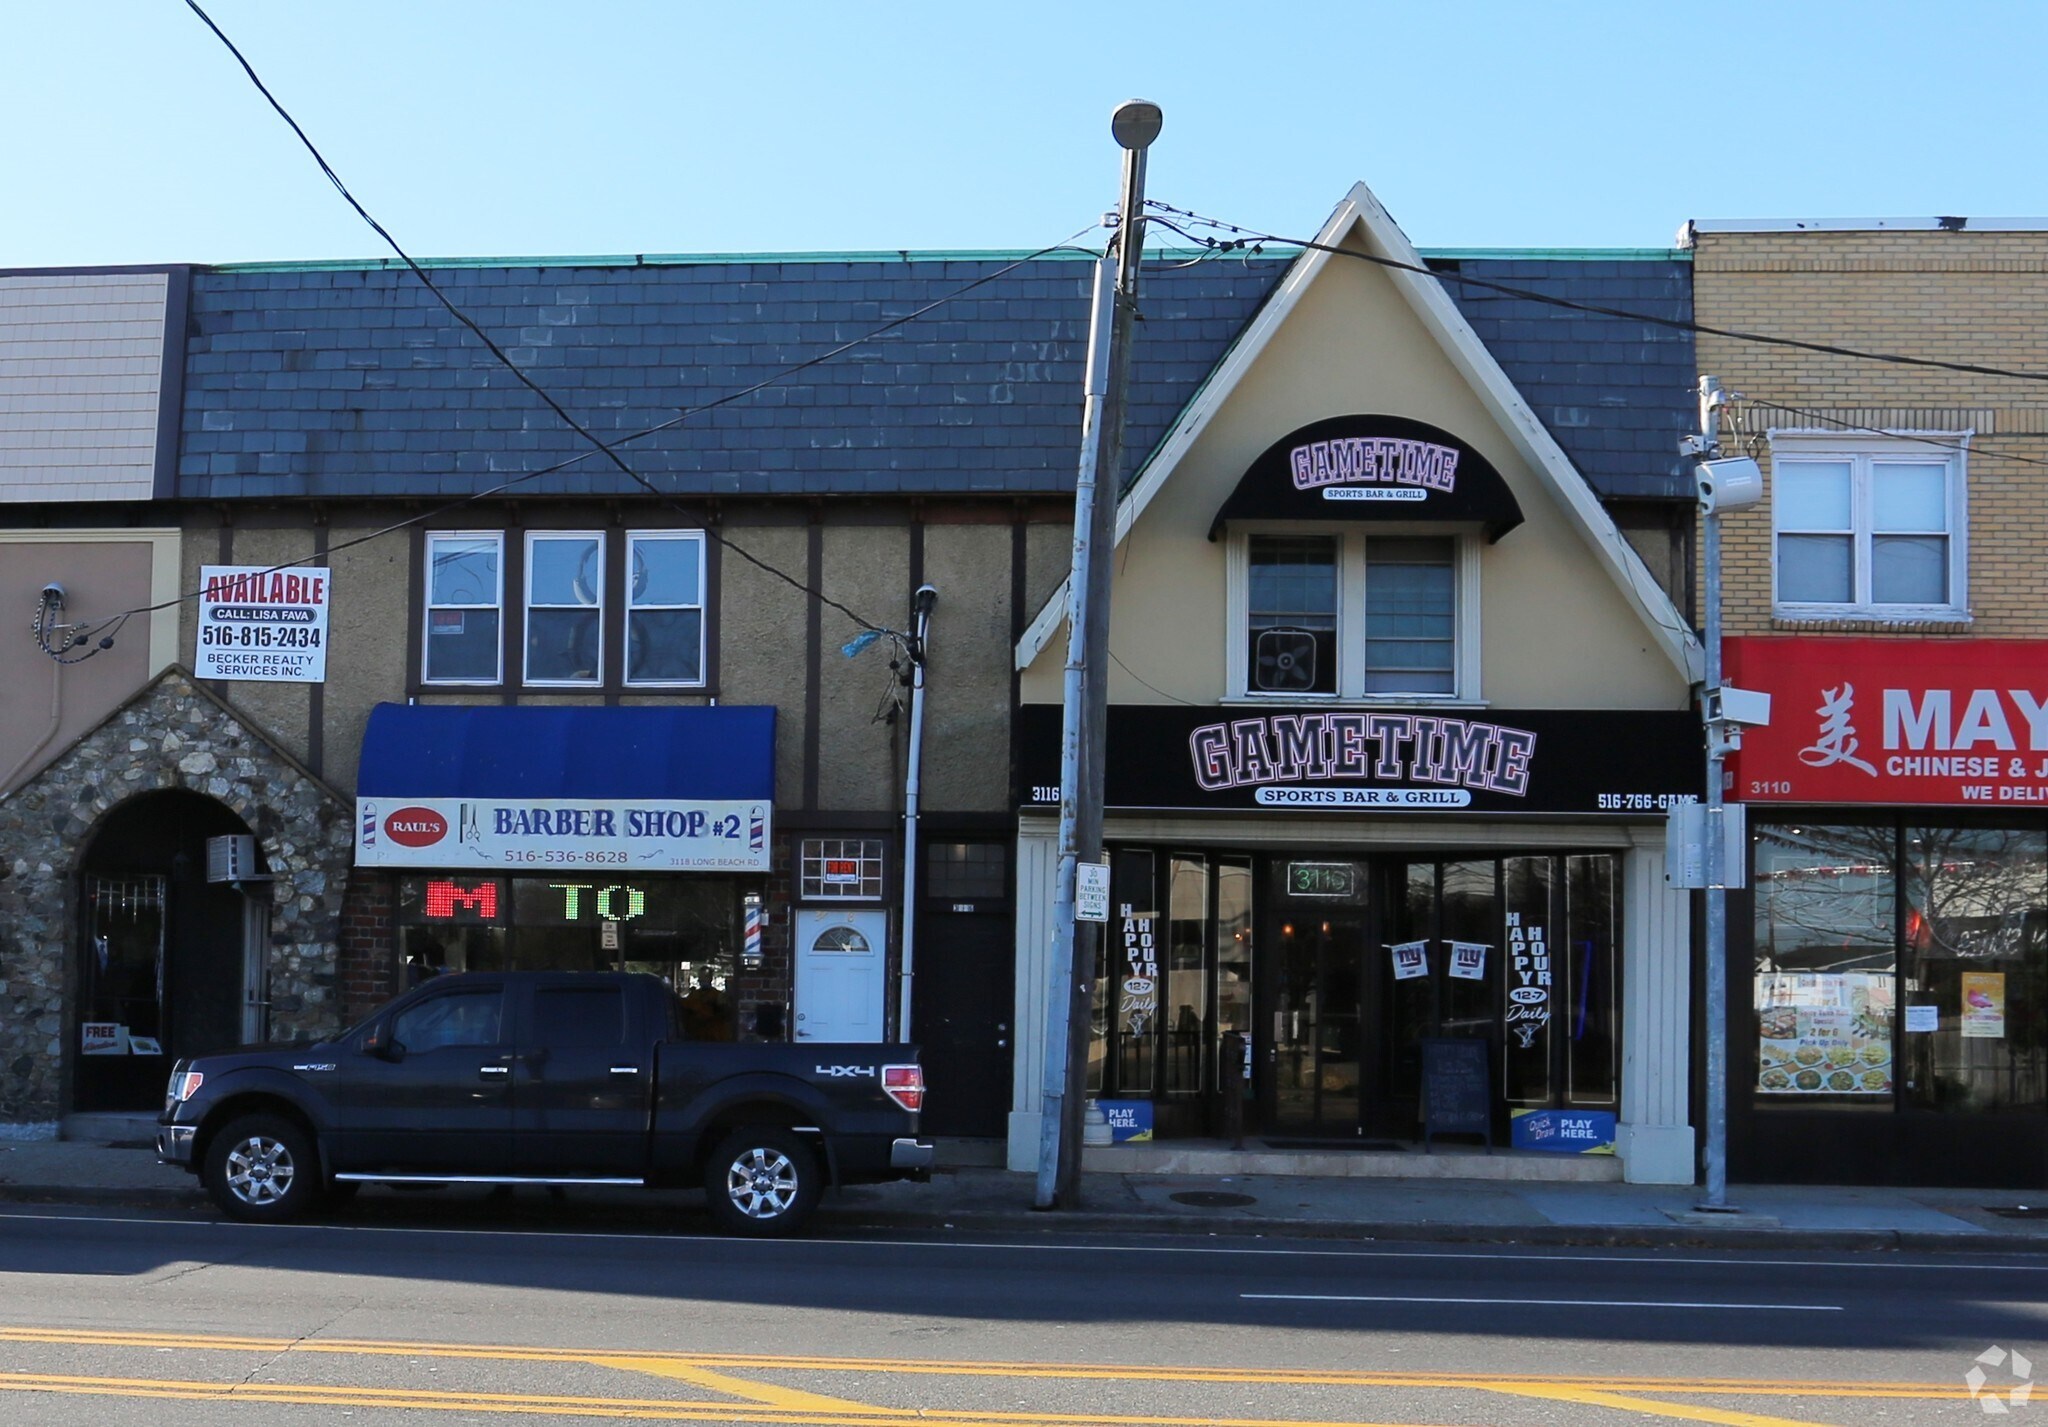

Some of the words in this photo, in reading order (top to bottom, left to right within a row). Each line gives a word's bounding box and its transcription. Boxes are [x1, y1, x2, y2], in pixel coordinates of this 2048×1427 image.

[1290, 437, 1459, 493] GAMETIME
[1328, 490, 1363, 499] SPORTS
[1366, 490, 1383, 499] BAR
[1386, 490, 1394, 499] &
[1396, 491, 1423, 500] GRILL
[205, 572, 324, 605] AVAILABLE
[216, 609, 251, 620] CALL:
[252, 610, 279, 620] LISA
[281, 611, 309, 621] FAVA
[202, 625, 321, 648] 516-815-2434
[207, 653, 259, 665] BECKER
[263, 655, 314, 666] REALTY
[216, 665, 278, 676] SERVICES
[281, 666, 305, 677] INC.
[1882, 688, 2048, 751] MAY
[1189, 712, 1537, 797] GAMETIME
[1886, 756, 2000, 778] CHINESE
[2008, 757, 2027, 778] &
[1032, 786, 1060, 801] 3116
[1751, 781, 1791, 794] 3110
[1961, 786, 1993, 800] WE
[1999, 786, 2048, 801] DELI
[1264, 790, 1335, 803] SPORTS
[1342, 791, 1380, 803] BAR
[1387, 791, 1400, 803] &
[1405, 791, 1461, 804] GRILL
[392, 821, 441, 833] RAUL'S
[494, 808, 617, 837] BARBER
[628, 809, 706, 838] SHOP
[712, 815, 741, 839] #2
[505, 851, 628, 863] 516-536-8628
[669, 857, 690, 866] 3118
[692, 858, 715, 866] LONG
[718, 859, 746, 867] BEACH
[1087, 878, 1099, 886] MIN
[1080, 885, 1106, 894] PARKING
[1079, 892, 1107, 901] BETWEEN
[1083, 900, 1102, 910] SIGNS
[1120, 903, 1142, 976] HAPPY
[1138, 918, 1158, 977] HOUR
[1506, 912, 1533, 985] HAPPY
[1528, 926, 1552, 986] HOUR
[1127, 982, 1151, 991] 12-7
[1514, 991, 1543, 1000] 12-7
[1120, 994, 1158, 1016] Daily
[1505, 1004, 1551, 1026] Daily
[85, 1026, 116, 1038] FREE
[1818, 1028, 1831, 1037] for
[1109, 1108, 1134, 1118] PLAY
[1528, 1116, 1551, 1132] Quick
[1561, 1118, 1593, 1129] PLAY
[1535, 1127, 1556, 1140] Draw
[1560, 1129, 1598, 1139] HERE.
